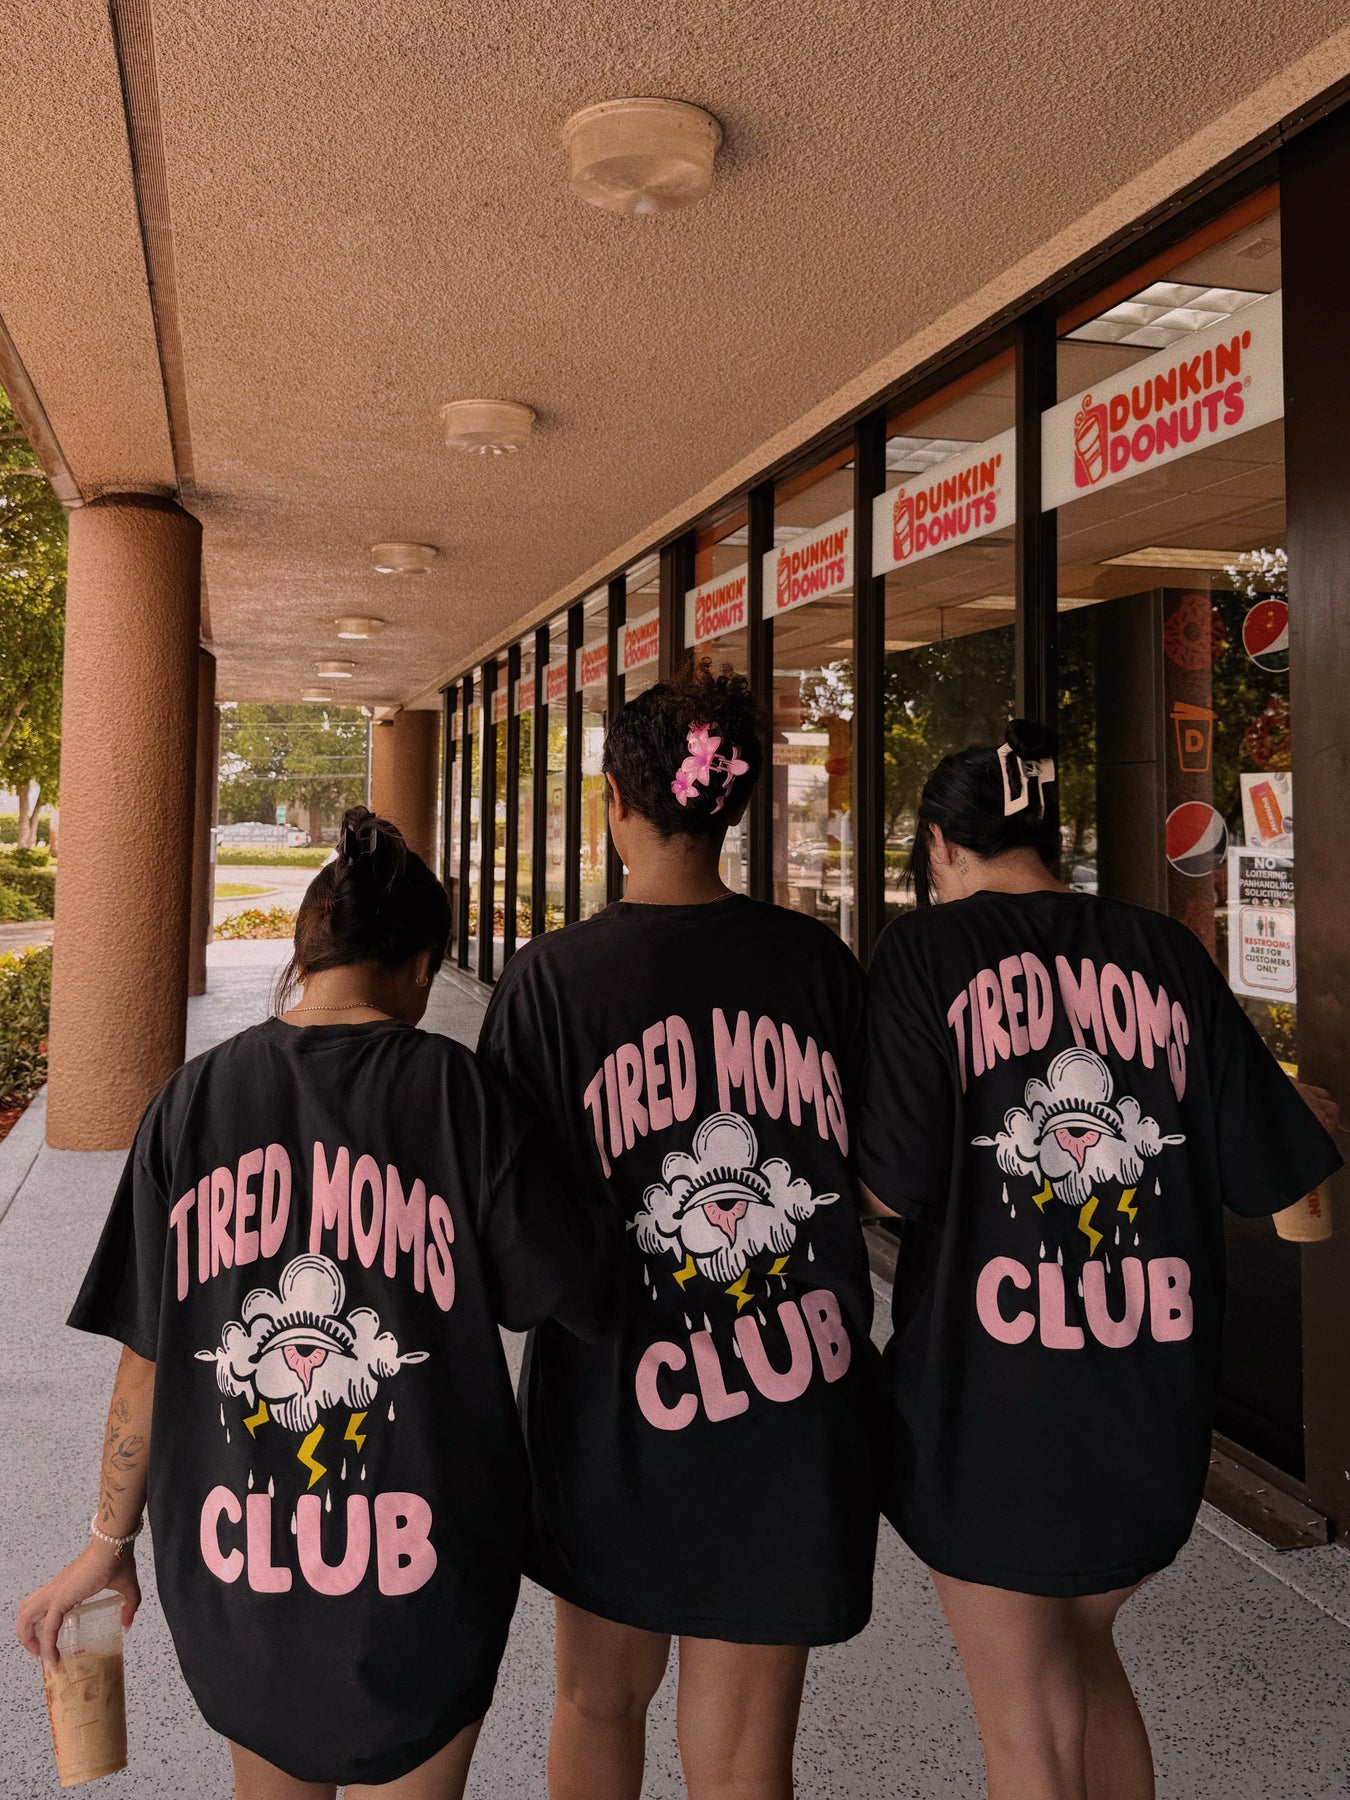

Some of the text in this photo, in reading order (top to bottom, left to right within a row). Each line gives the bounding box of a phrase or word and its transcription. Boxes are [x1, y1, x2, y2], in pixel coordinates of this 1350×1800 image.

[1110, 330, 1251, 432] DUNKIN'
[1110, 381, 1244, 473] DONUTS
[915, 454, 1001, 520] DUNKIN'
[915, 491, 996, 552] DONUTS
[791, 527, 848, 575] DUNKIN'
[705, 576, 746, 613] DUNKIN'
[791, 557, 844, 602] DONUTS
[705, 601, 743, 635] DONUTS
[1184, 729, 1204, 753] D
[1240, 879, 1294, 891] PANHANDLING
[1245, 869, 1287, 880] LOITERING
[1254, 857, 1276, 870] NO
[1244, 888, 1288, 899] SOLICITING
[1245, 937, 1290, 949] RESTROOMS
[1245, 954, 1291, 967] CUSTOMERS
[1250, 946, 1282, 957] ARE FOR
[1256, 964, 1278, 974] ONLY
[947, 951, 1190, 1103] TIRED MOMS
[583, 1007, 849, 1179] TIRED MOMS
[169, 1141, 455, 1312] TIRED MOMS
[976, 1255, 1194, 1350] CLUB
[635, 1288, 852, 1431] CLUB
[200, 1485, 438, 1596] CLUB
